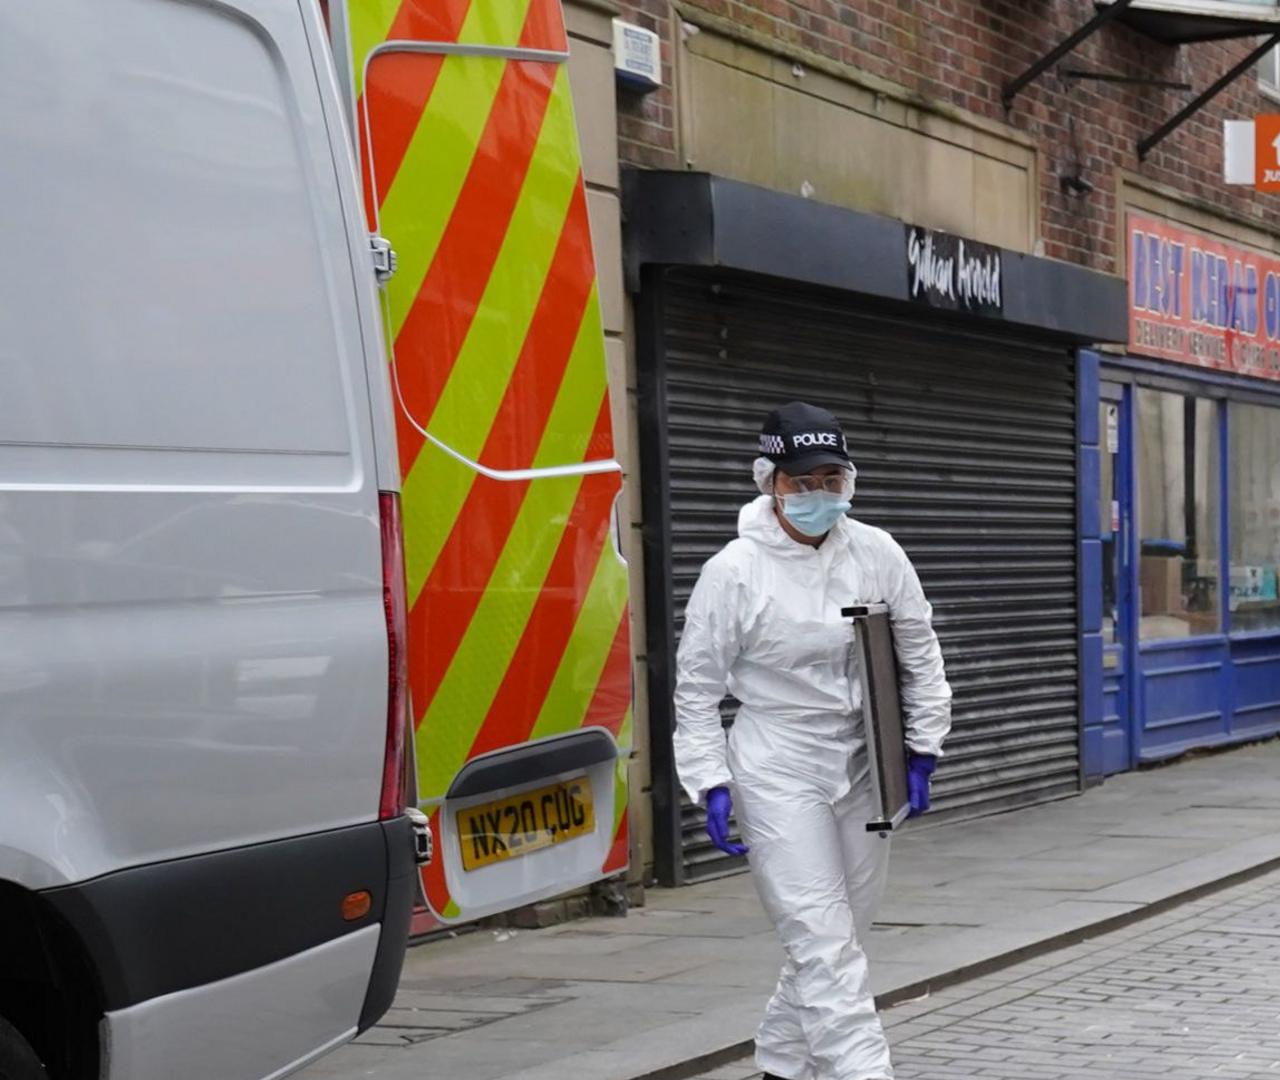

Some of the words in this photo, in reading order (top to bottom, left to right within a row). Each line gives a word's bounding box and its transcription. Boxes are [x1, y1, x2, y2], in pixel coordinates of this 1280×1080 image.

[1131, 229, 1186, 320] BEST
[1188, 246, 1260, 337] KEBAB
[792, 432, 839, 449] POLICE
[469, 800, 538, 861] NX20
